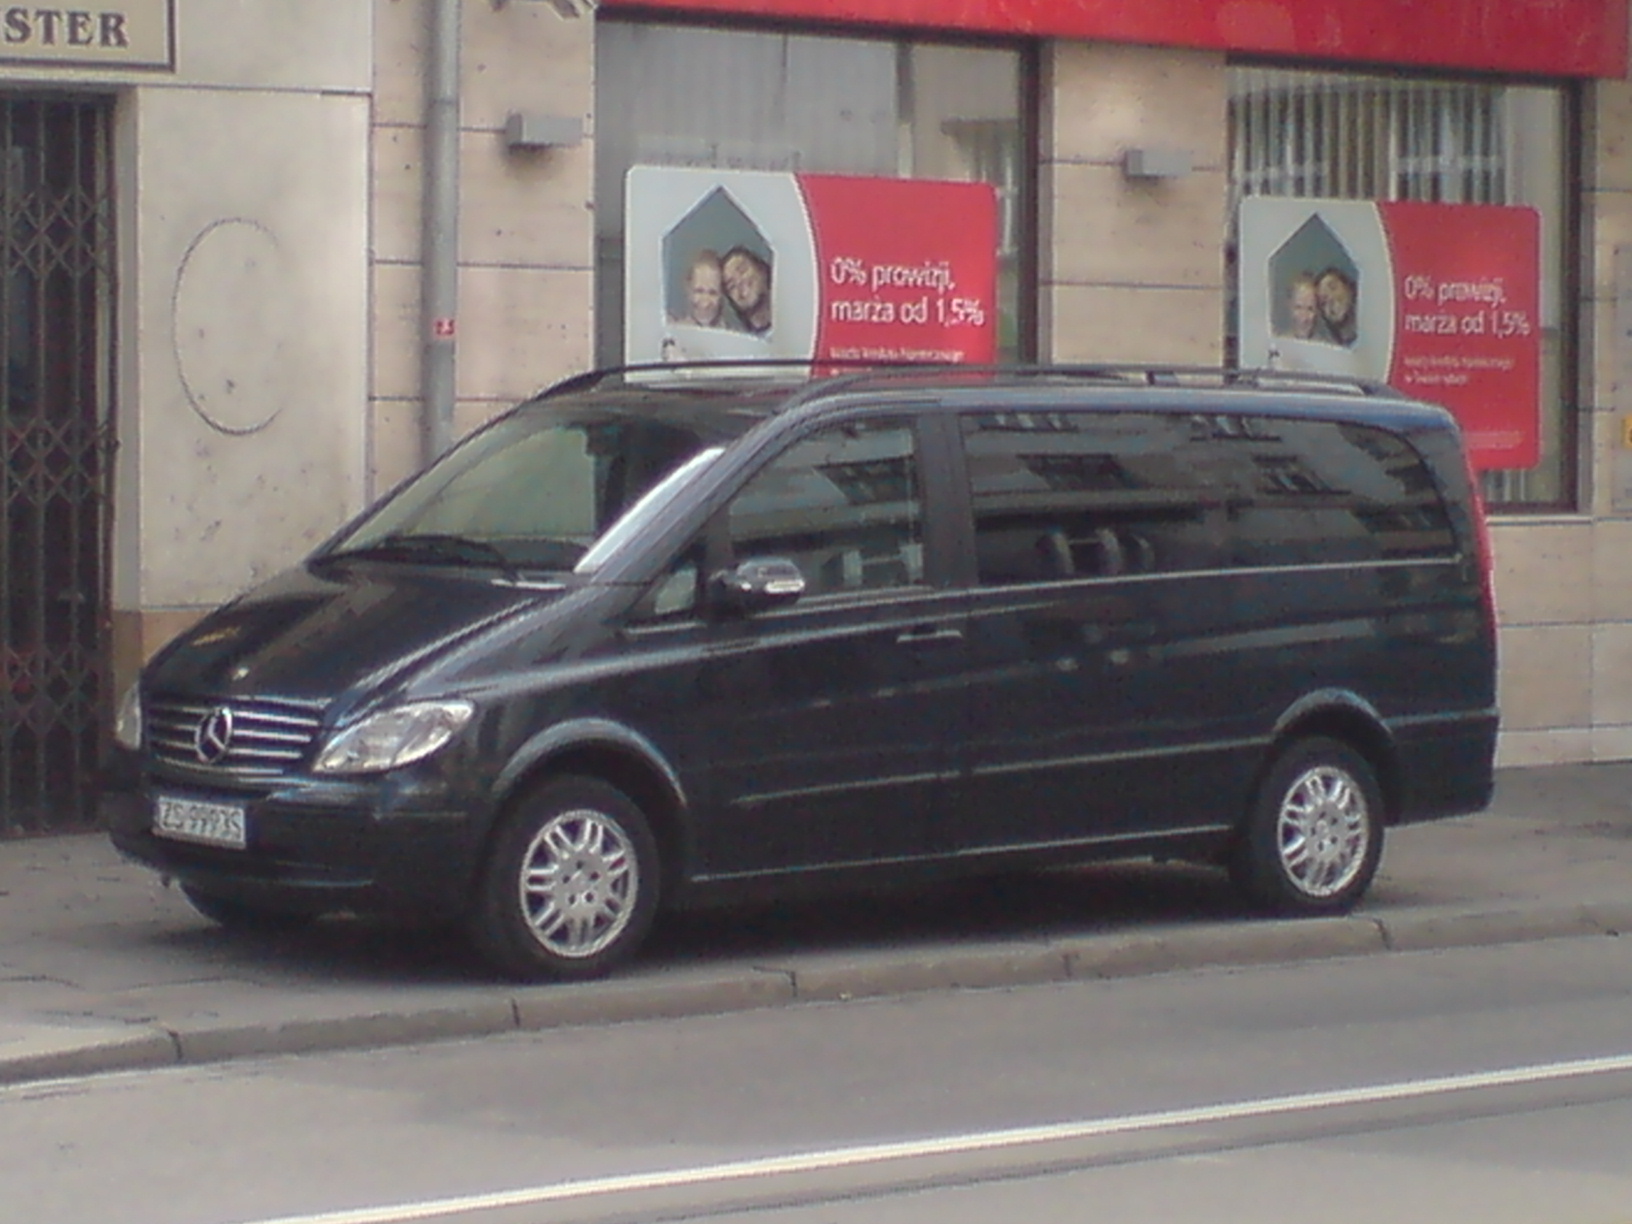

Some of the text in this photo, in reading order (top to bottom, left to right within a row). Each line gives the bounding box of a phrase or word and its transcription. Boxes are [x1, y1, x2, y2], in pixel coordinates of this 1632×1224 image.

[830, 257, 867, 286] 0%
[1404, 275, 1434, 300] 0%
[831, 294, 985, 327] marża od 1,5%
[1461, 310, 1485, 334] od
[1491, 311, 1531, 339] 1,5%
